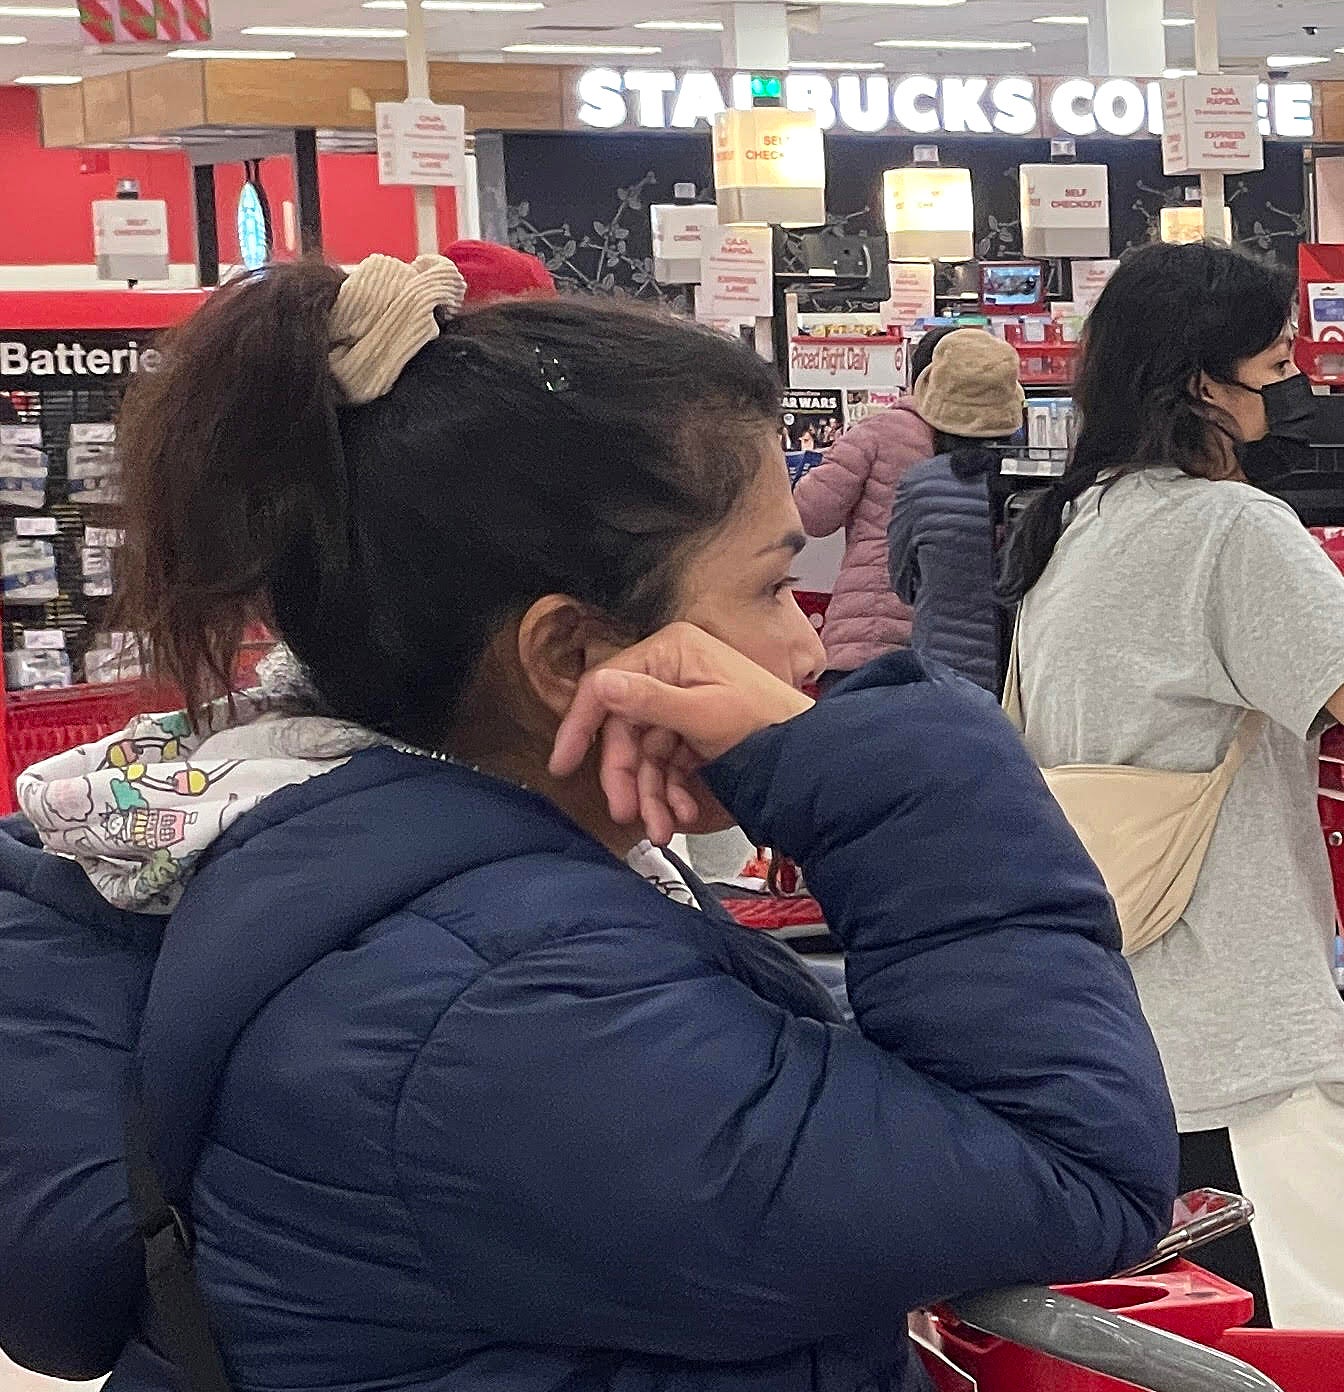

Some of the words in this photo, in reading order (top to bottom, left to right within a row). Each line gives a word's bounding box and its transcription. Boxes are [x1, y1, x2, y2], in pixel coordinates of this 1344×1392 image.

[577, 66, 1039, 134] STABUCKS
[1051, 77, 1314, 137] COE
[0, 341, 161, 376] Batterie
